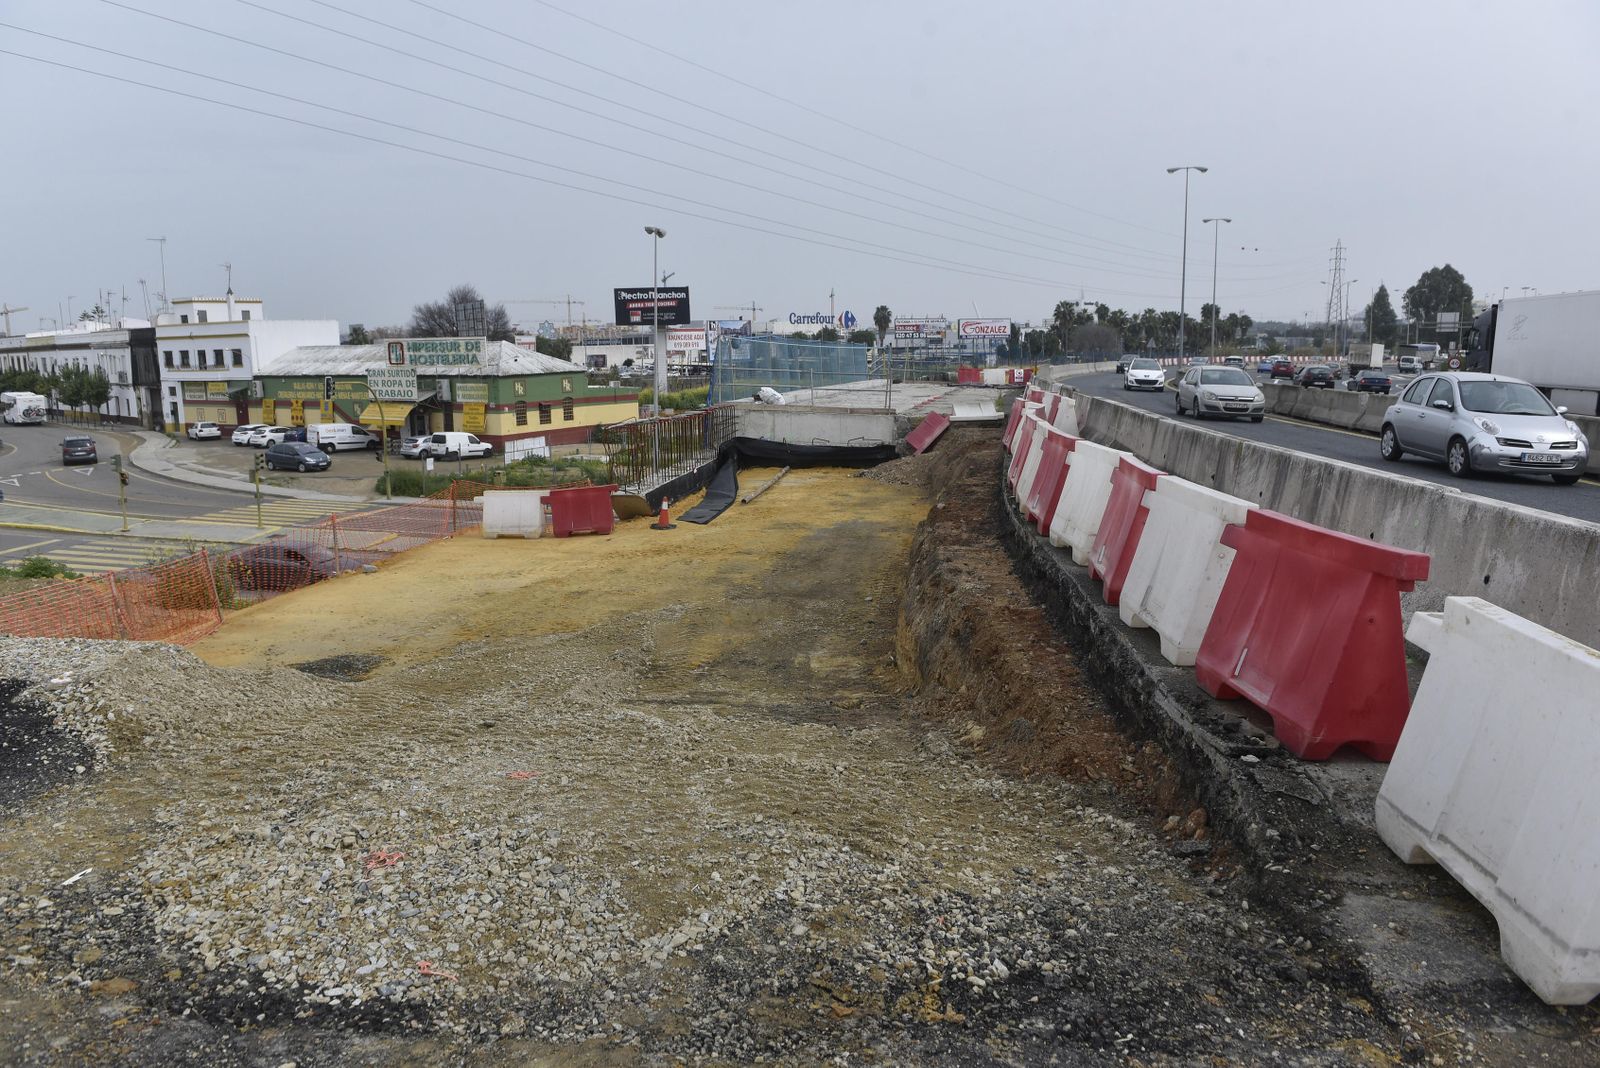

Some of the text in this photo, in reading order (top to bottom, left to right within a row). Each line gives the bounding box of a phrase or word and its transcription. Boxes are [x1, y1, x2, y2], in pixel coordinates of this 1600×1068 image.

[789, 312, 835, 325] Carrefour
[961, 321, 1007, 334] GONZALEZ
[407, 341, 461, 353] HIPERSUR
[464, 341, 481, 352] DE
[408, 354, 480, 365] HOSTELERIA
[368, 369, 416, 377] GRAN SURTIDO
[381, 380, 403, 388] ROPA
[374, 389, 413, 397] TRABAJO
